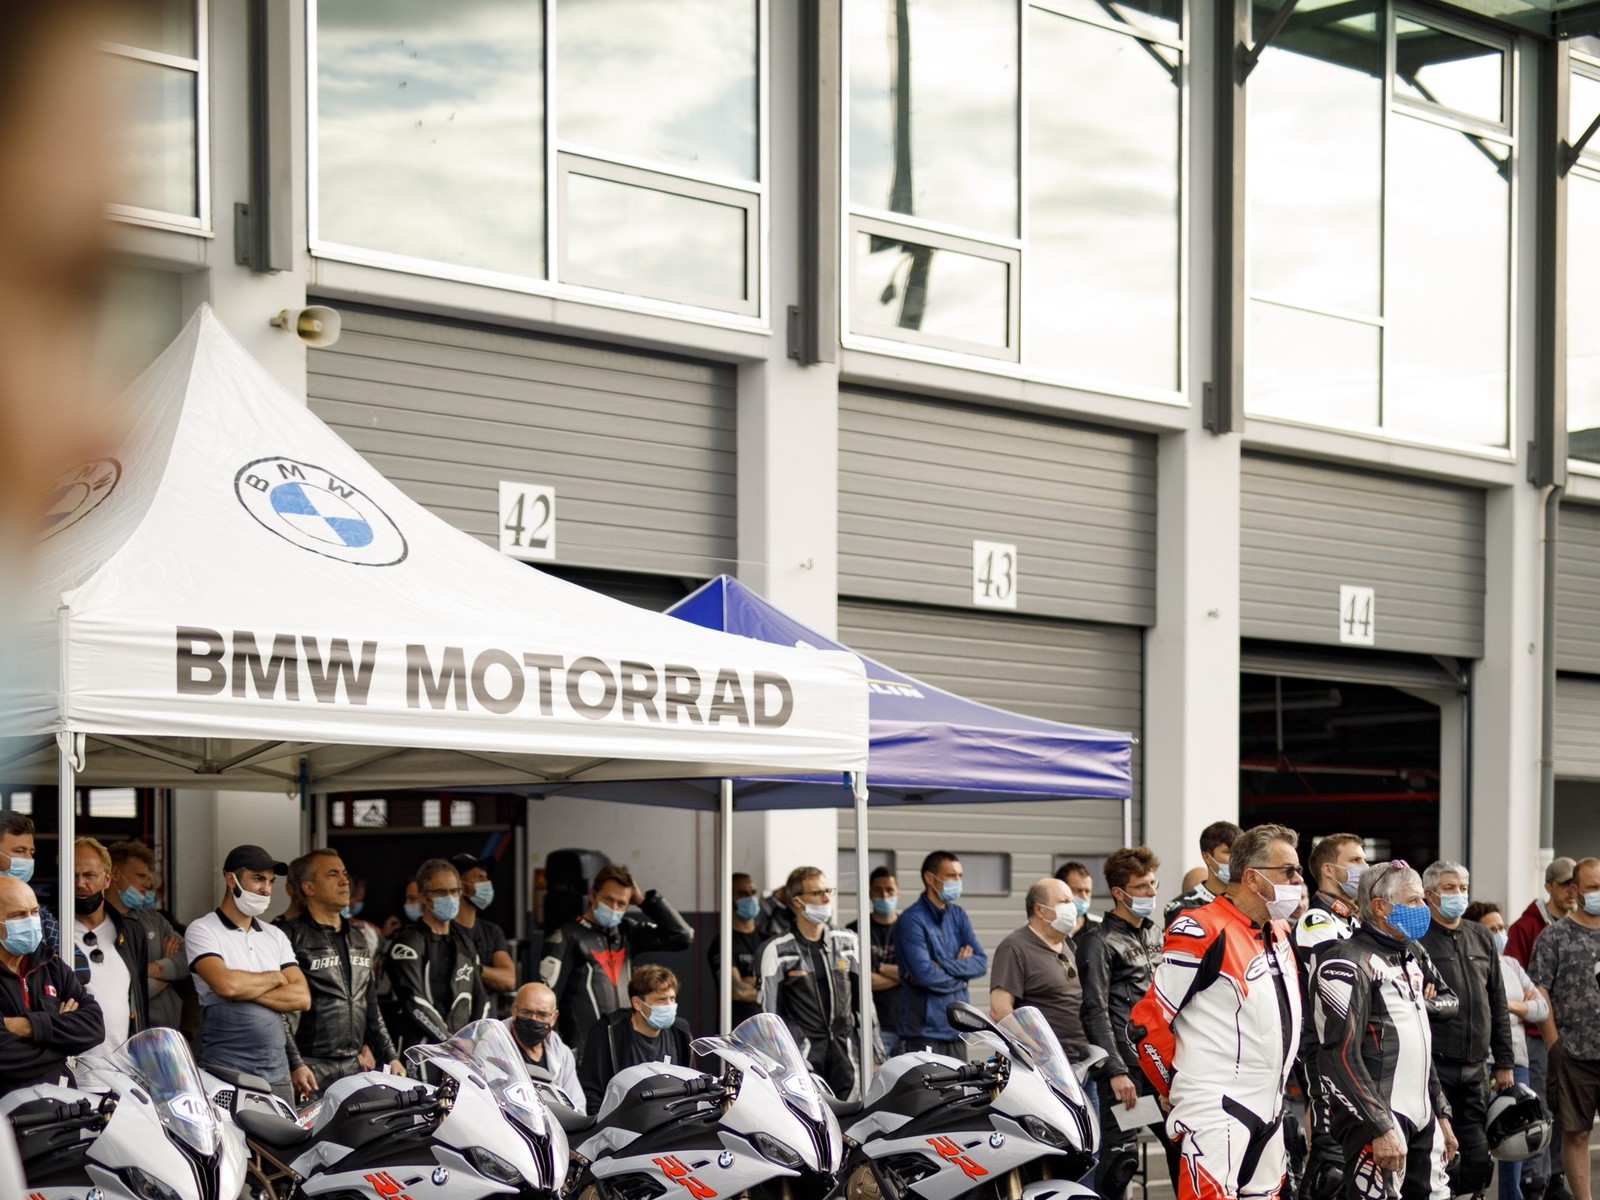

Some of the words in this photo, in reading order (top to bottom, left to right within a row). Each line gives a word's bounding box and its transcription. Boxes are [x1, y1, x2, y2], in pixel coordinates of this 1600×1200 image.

[245, 463, 355, 499] BMW
[504, 492, 551, 550] 42
[977, 550, 1012, 601] 43
[1343, 594, 1371, 637] 44
[175, 625, 378, 706] BMW
[406, 643, 795, 730] MOTORRAD
